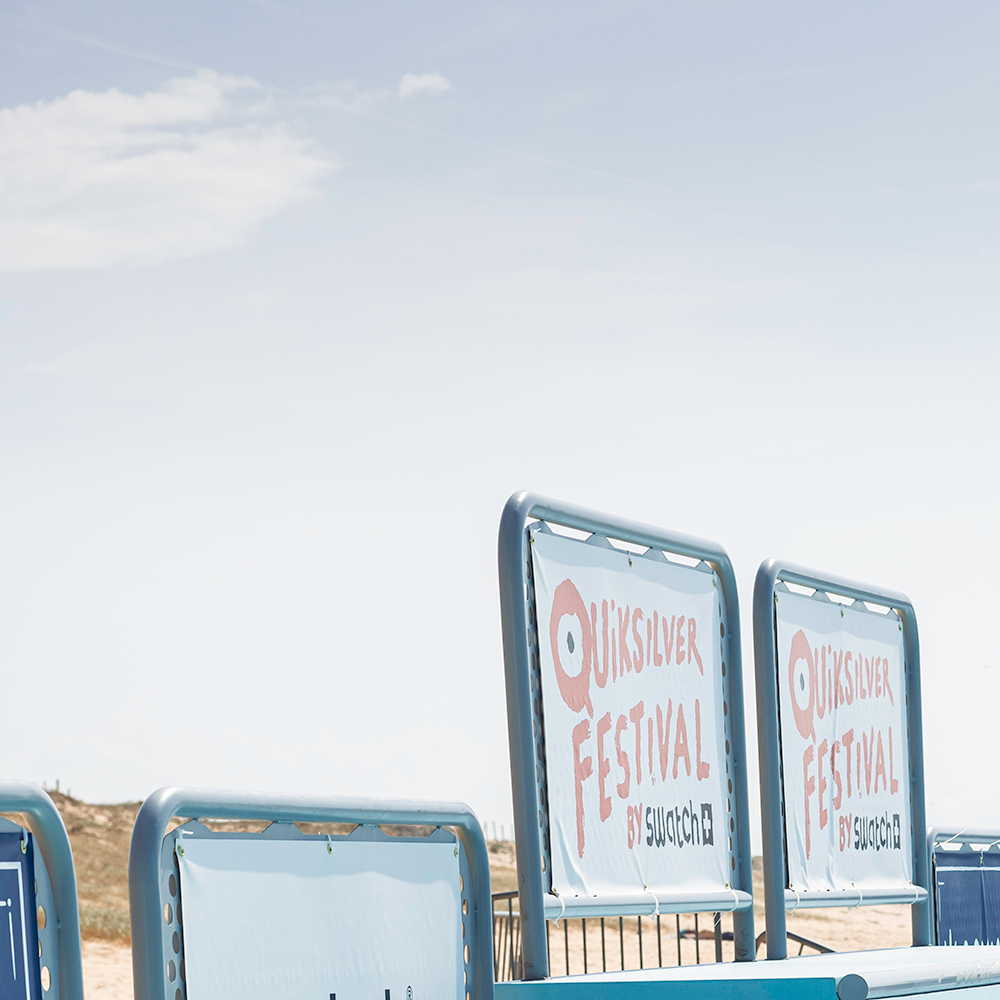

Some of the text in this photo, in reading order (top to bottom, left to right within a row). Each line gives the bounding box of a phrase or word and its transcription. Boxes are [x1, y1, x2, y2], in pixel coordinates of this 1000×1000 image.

[572, 698, 710, 859] FESTIVAL
[627, 799, 700, 849] BY swatch
[803, 725, 899, 860] FESTIVAL
[839, 810, 892, 852] BY swatch
